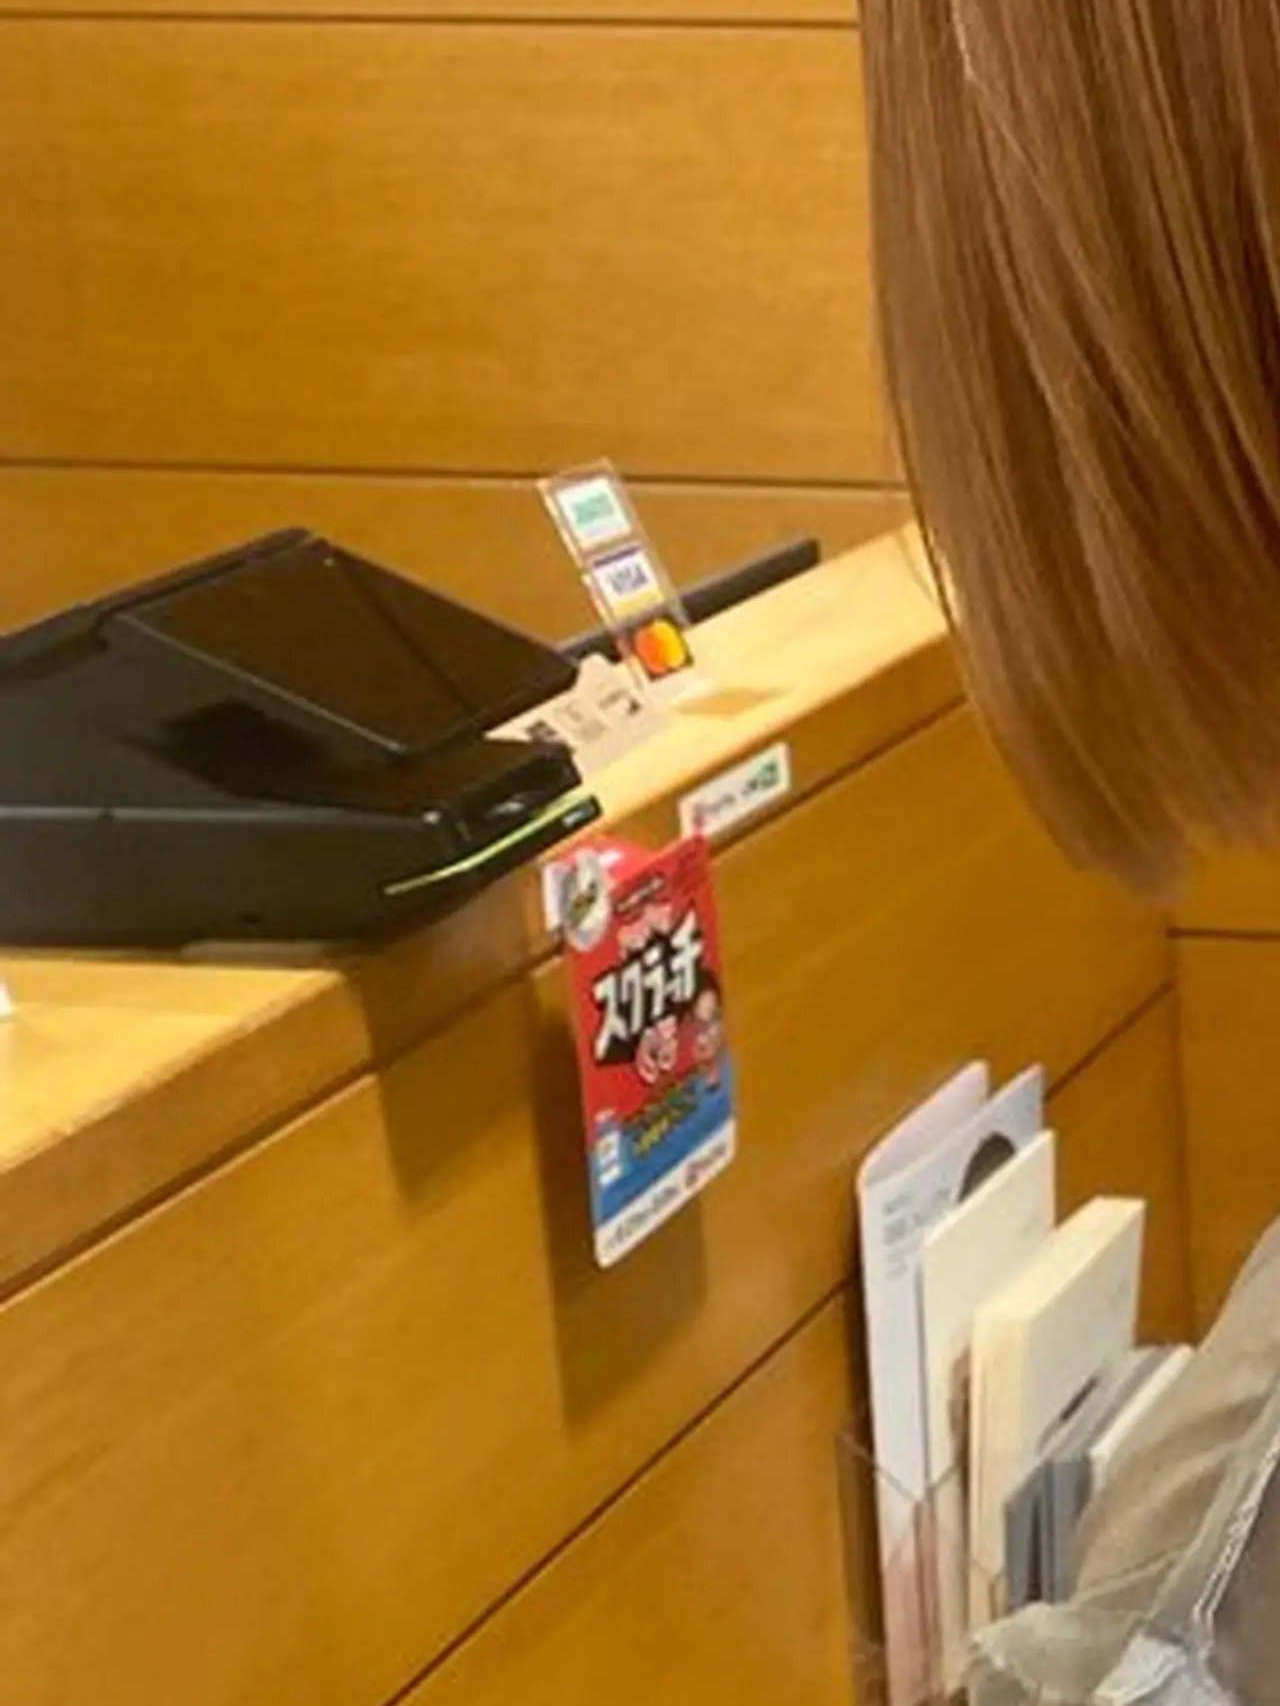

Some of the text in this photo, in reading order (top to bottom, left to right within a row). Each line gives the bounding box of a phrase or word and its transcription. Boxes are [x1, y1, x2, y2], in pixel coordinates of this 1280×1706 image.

[607, 563, 648, 596] VISA
[593, 907, 703, 1061] スクラッチ
